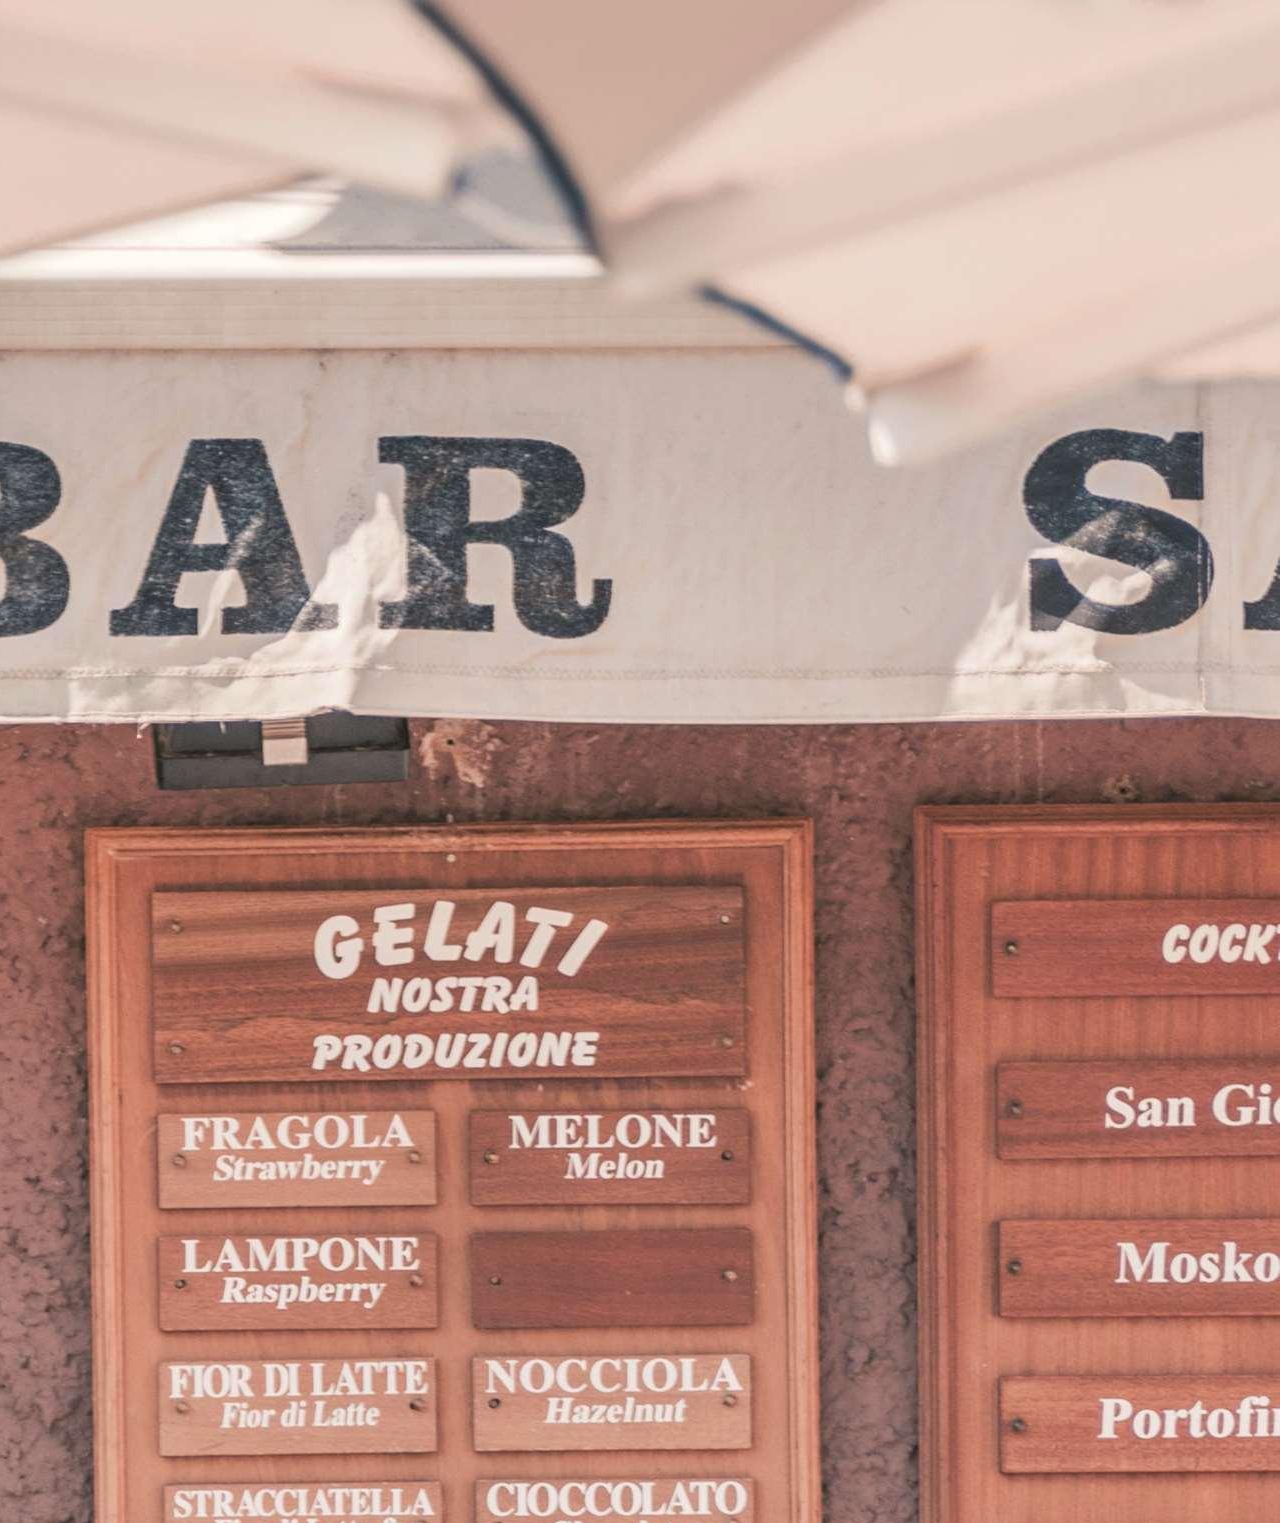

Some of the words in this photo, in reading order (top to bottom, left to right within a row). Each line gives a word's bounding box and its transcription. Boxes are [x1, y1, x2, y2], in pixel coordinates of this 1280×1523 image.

[313, 900, 609, 980] GELATI
[1162, 923, 1280, 965] COCK
[366, 976, 539, 1014] NOSTRA
[312, 1032, 600, 1071] PRODUZIONE
[1104, 1086, 1197, 1129] San
[181, 1114, 414, 1151] FRAGOLA
[509, 1113, 717, 1149] MELONE
[213, 1154, 386, 1186] Strawberry
[564, 1153, 665, 1180] Melon
[182, 1237, 420, 1273] LAMPONE
[1114, 1241, 1280, 1284] Mosko
[220, 1276, 386, 1308] Raspberry
[169, 1364, 252, 1399] FIOR
[264, 1363, 305, 1397] DI
[312, 1361, 428, 1396] LATTE
[485, 1358, 742, 1393] NOCCIOLA
[220, 1402, 270, 1429] Fior
[279, 1402, 307, 1427] di
[313, 1402, 380, 1427] Latte
[545, 1398, 686, 1424] Hazelnut
[173, 1489, 434, 1519] STRACCIATELLA
[486, 1481, 747, 1515] CIOCCOLATO
